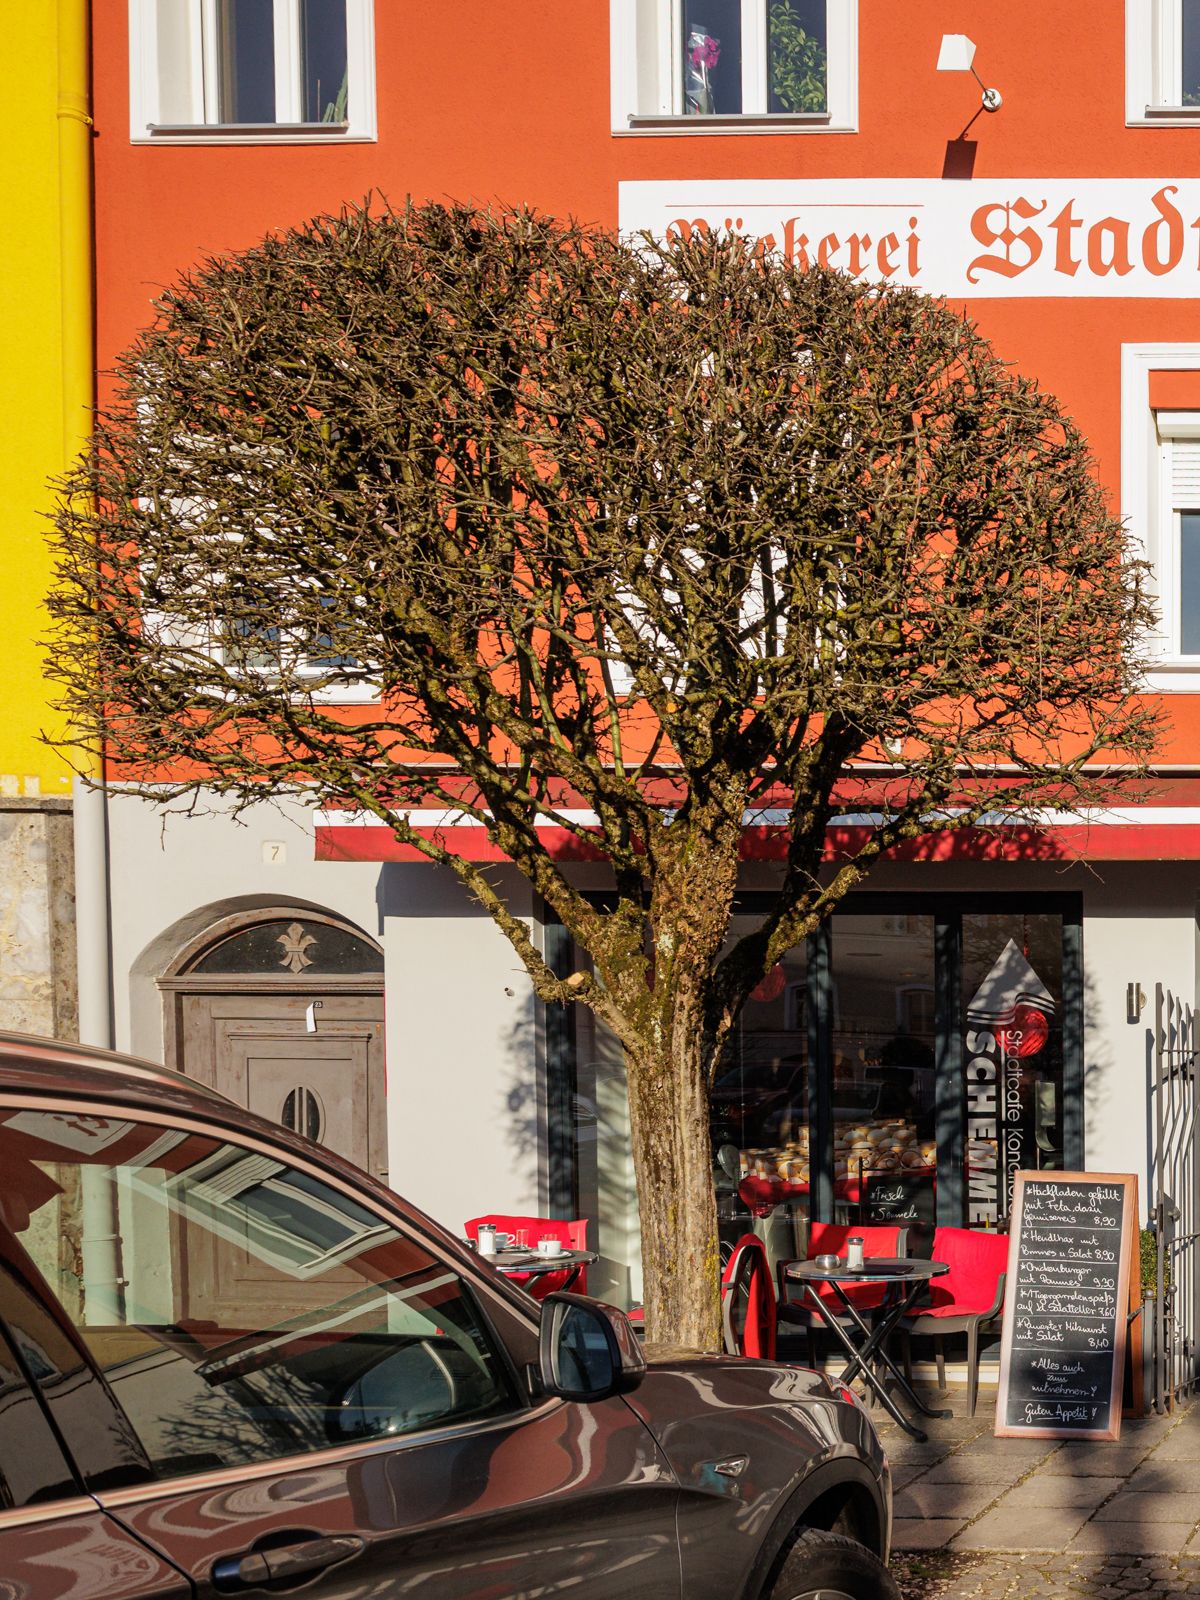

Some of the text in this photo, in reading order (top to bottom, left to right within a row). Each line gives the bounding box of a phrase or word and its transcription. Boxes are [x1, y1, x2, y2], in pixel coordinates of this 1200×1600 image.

[666, 216, 922, 278] ckerei
[271, 846, 280, 861] 7
[1007, 1030, 1023, 1122] Stadtcafe
[966, 1030, 997, 1234] SCHEMME
[1025, 1198, 1044, 1210] mit
[1094, 1216, 1116, 1227] 8,90
[1080, 1235, 1099, 1246] mit
[1068, 1247, 1093, 1259] Salat
[1094, 1249, 1115, 1261] 8,90
[1019, 1273, 1115, 1288] mit Pommes 9,30
[1016, 1300, 1033, 1315] auf
[1048, 1302, 1096, 1315] Salatteller
[1016, 1330, 1109, 1349] mit Salat 8,40
[1037, 1357, 1085, 1373] Alles auch
[1046, 1374, 1069, 1383] zum
[1025, 1402, 1053, 1423] Guten
